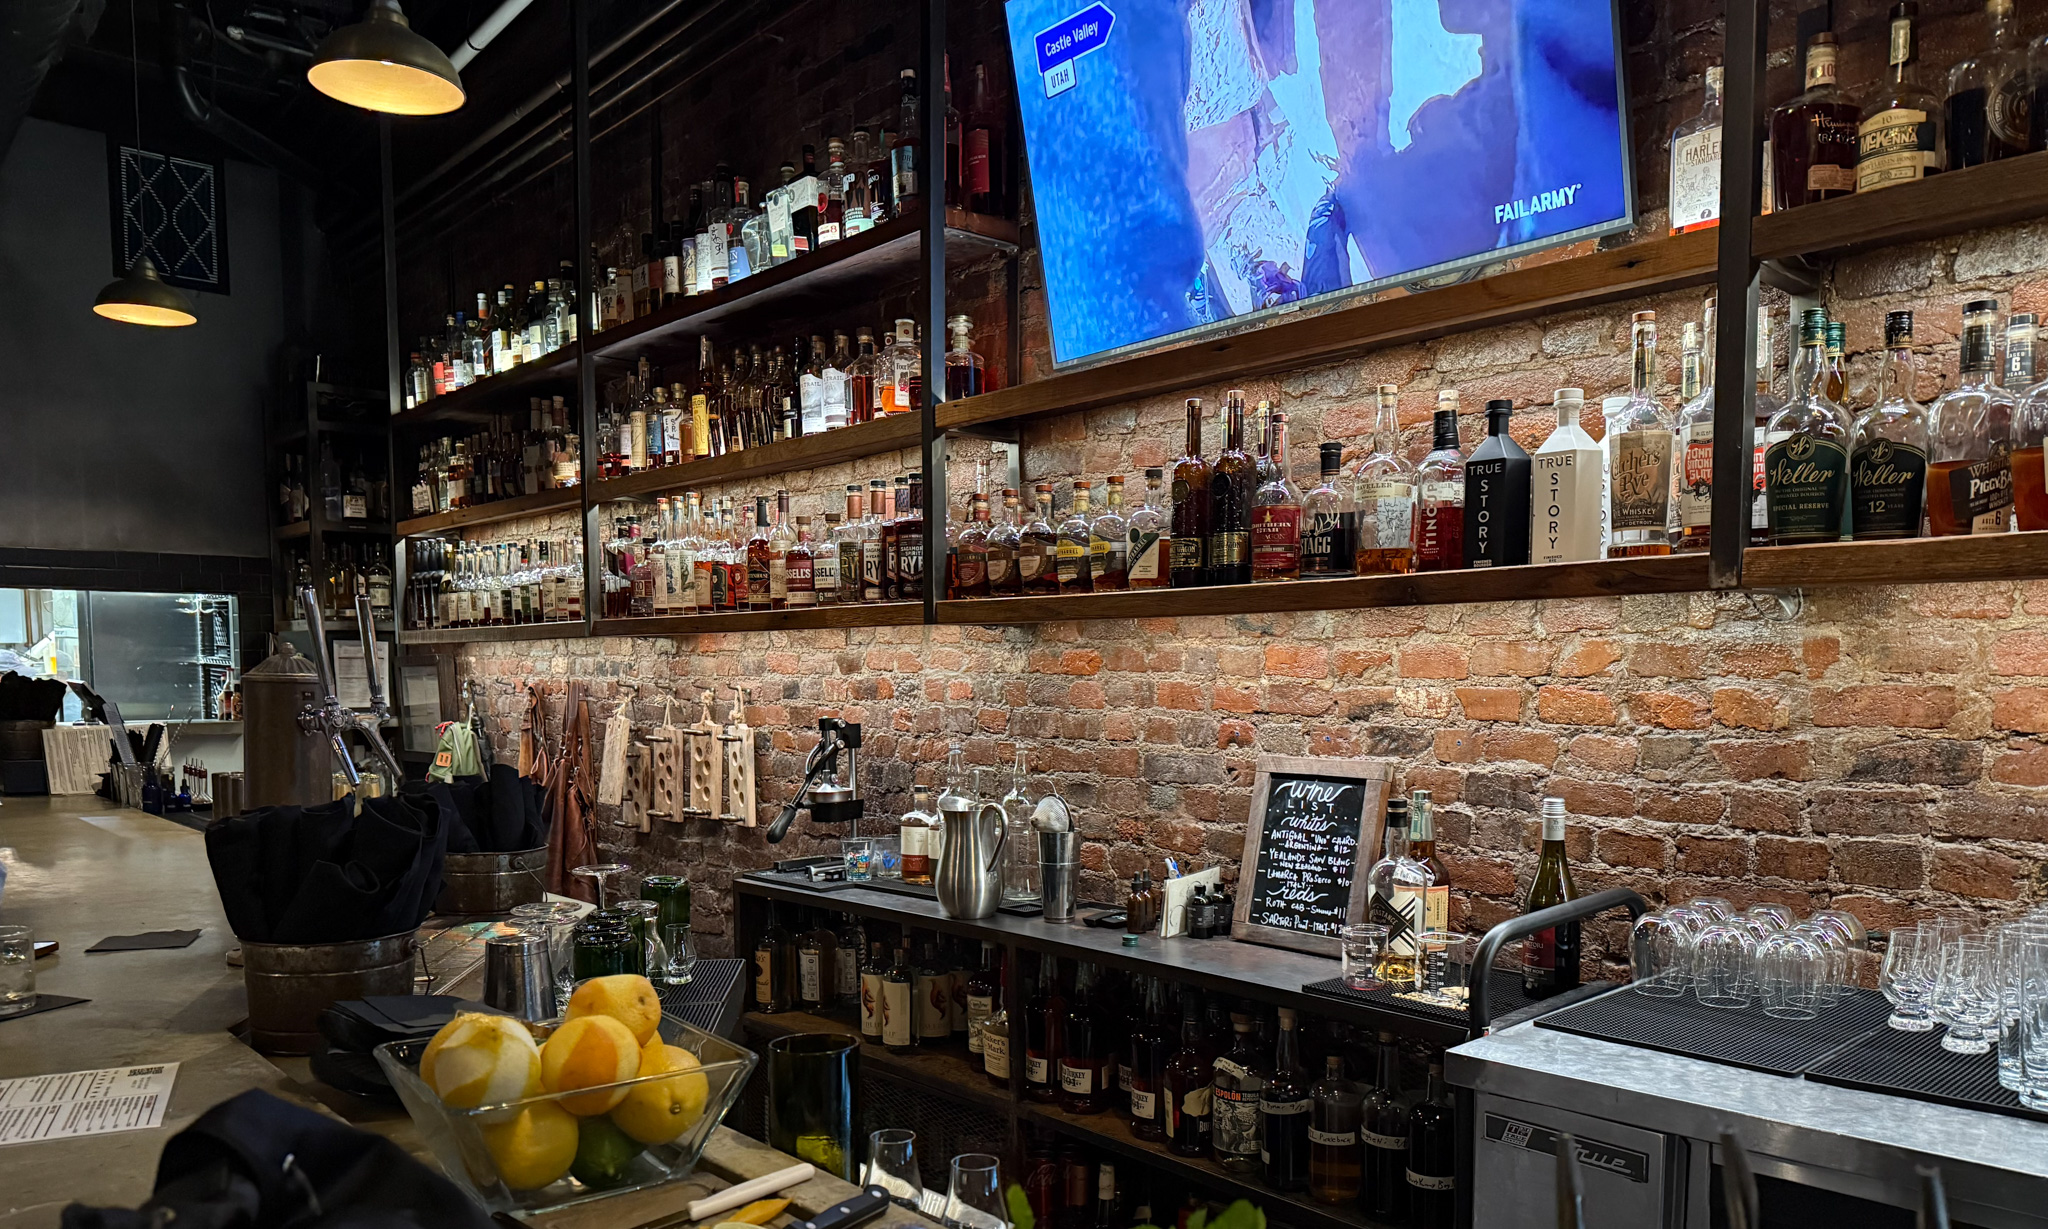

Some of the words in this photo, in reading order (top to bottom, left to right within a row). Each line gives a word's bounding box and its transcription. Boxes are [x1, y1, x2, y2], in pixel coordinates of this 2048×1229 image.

[1045, 34, 1072, 57] Castle
[1072, 21, 1099, 43] Valley
[1051, 68, 1070, 89] UTAH
[1881, 115, 1893, 125] 10
[1495, 184, 1577, 225] FAILARMY
[2012, 357, 2020, 371] 6
[1469, 463, 1502, 475] TRUE
[1539, 455, 1573, 469] TRUE
[1770, 458, 1835, 487] Weller
[1853, 460, 1915, 489] Weller
[1425, 484, 1439, 547] TINCUP
[1548, 472, 1560, 549] STORY
[1622, 507, 1656, 516] WHISKEY
[1868, 500, 1886, 513] 12
[1478, 479, 1490, 554] STORY
[1995, 511, 2001, 525] 6
[900, 556, 923, 575] RYE
[1274, 781, 1353, 802] wine
[1287, 799, 1334, 813] LIST
[1281, 814, 1338, 832] whites
